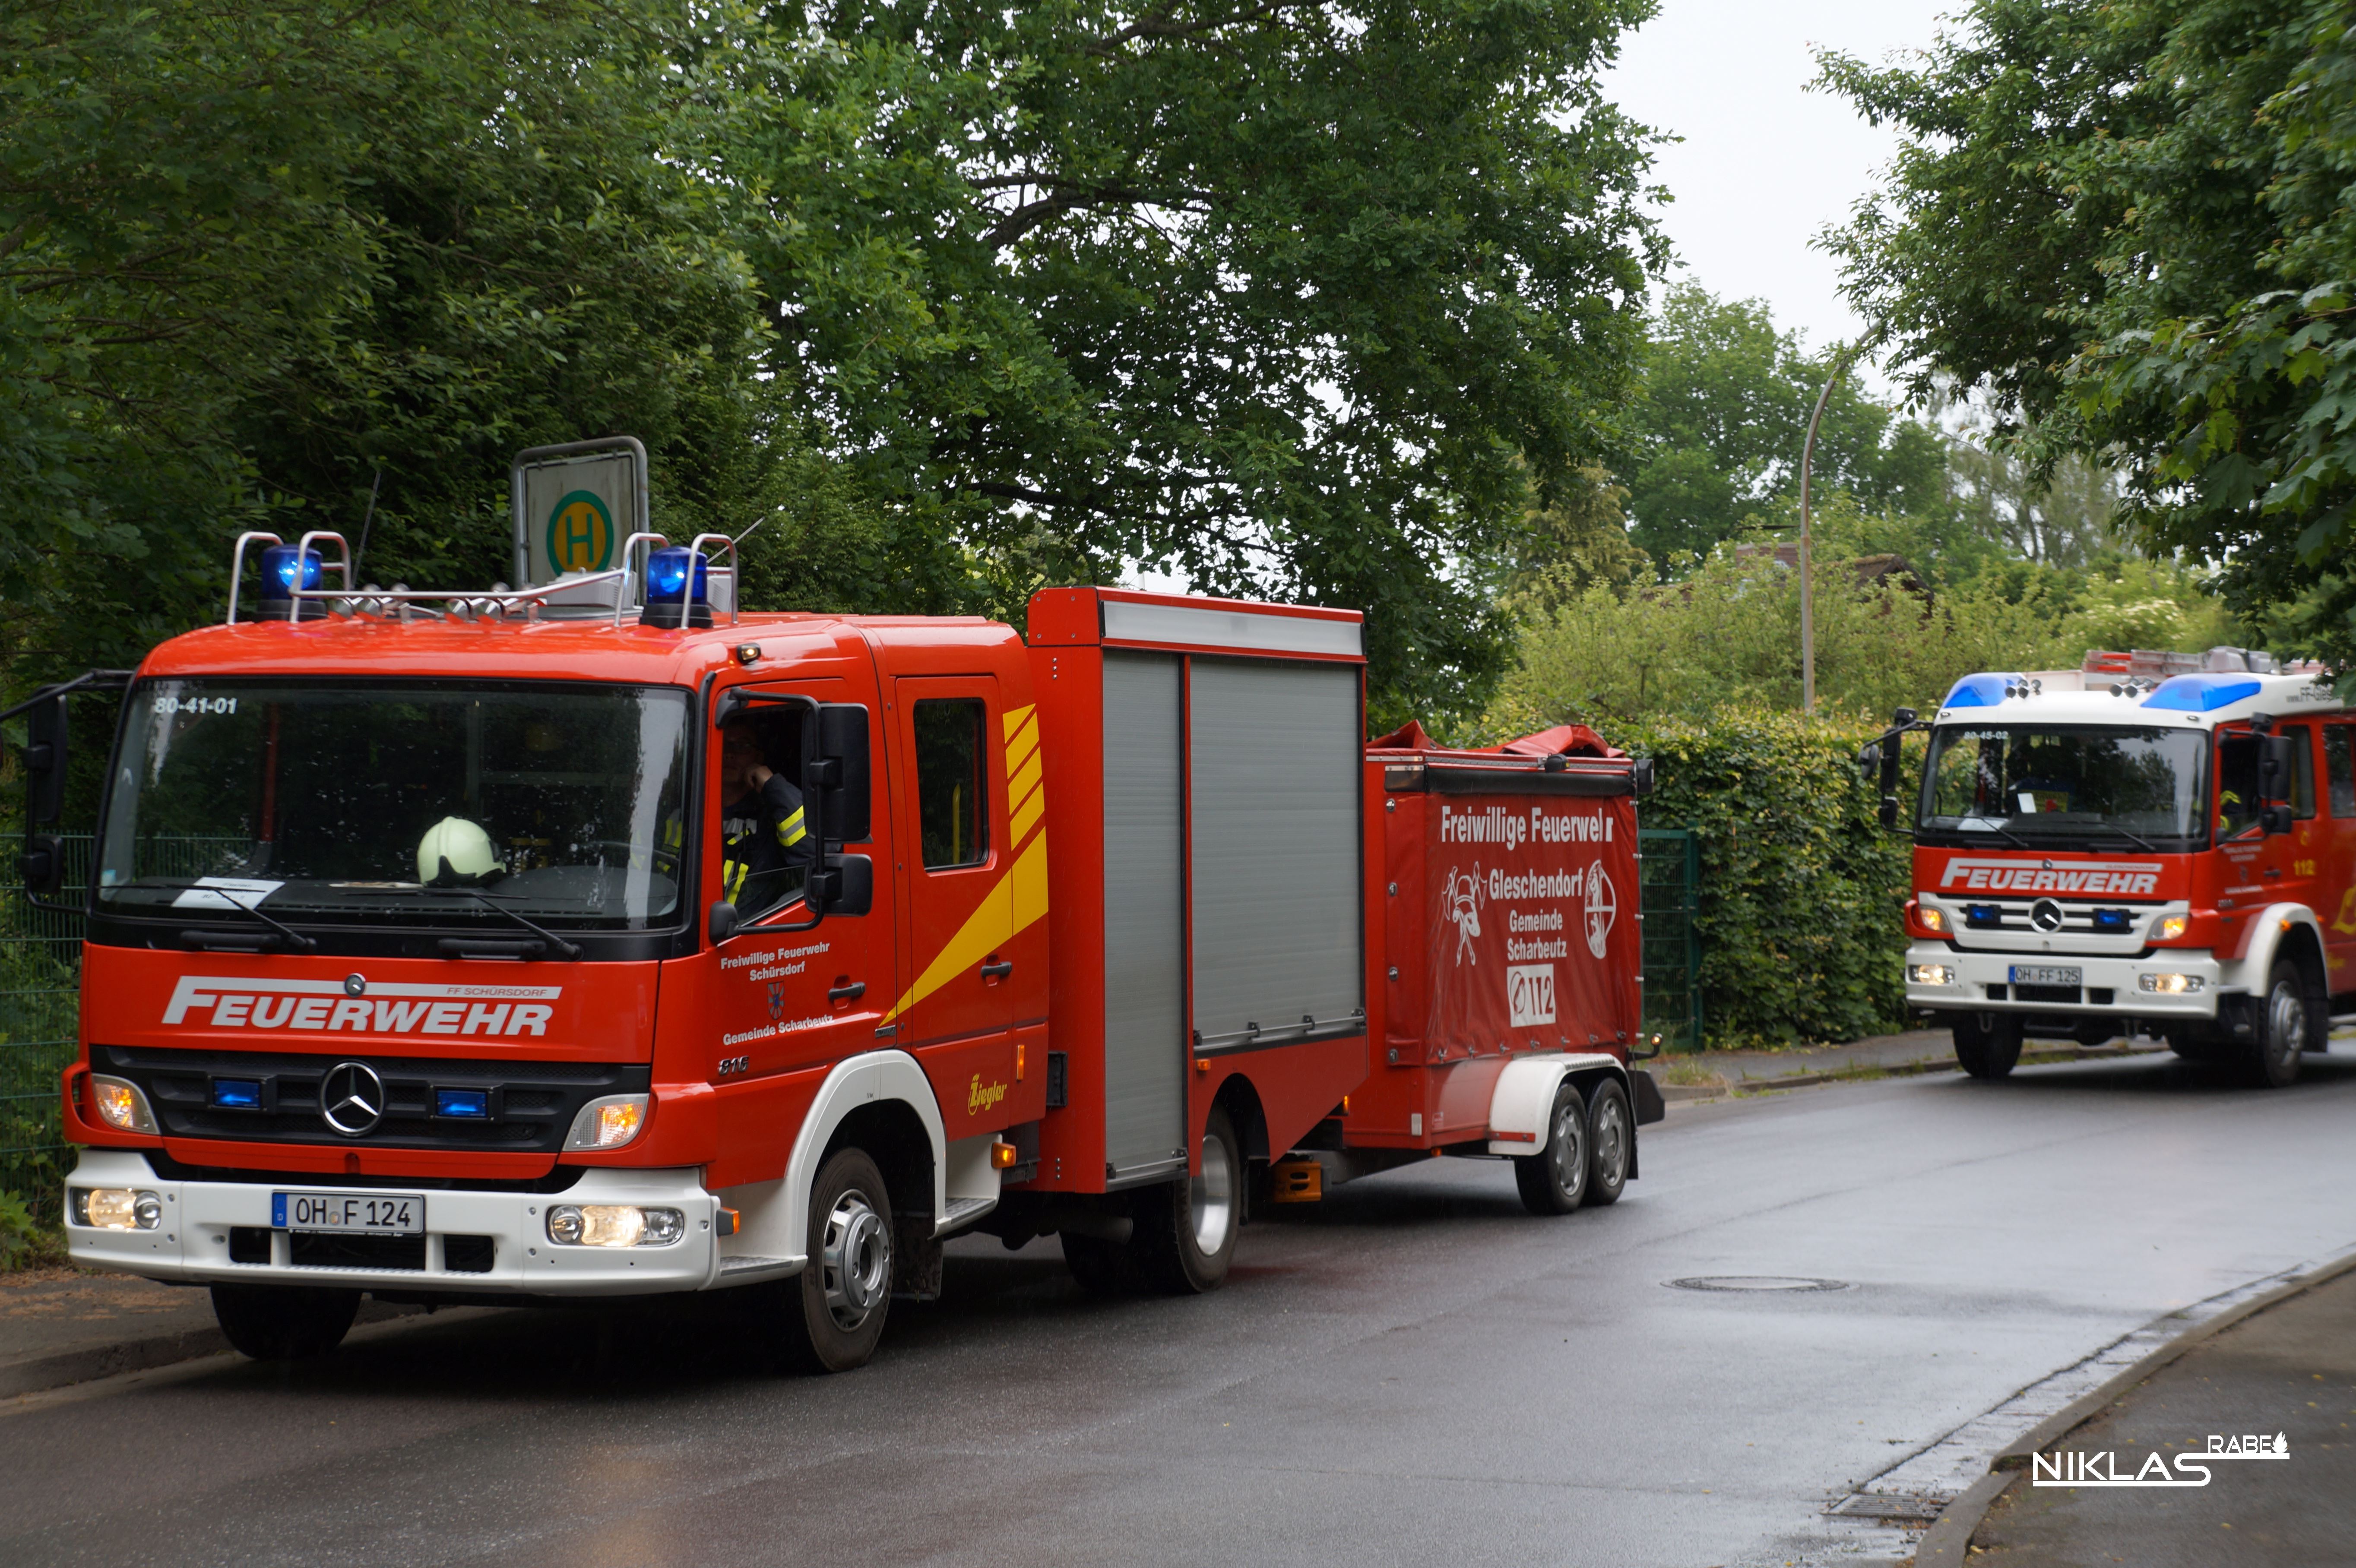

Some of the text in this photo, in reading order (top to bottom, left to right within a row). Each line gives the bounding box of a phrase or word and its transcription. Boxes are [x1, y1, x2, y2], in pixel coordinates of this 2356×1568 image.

[566, 513, 594, 565] H
[154, 697, 237, 714] 80-41-01
[1963, 731, 2009, 740] 80-45-02
[1441, 806, 1526, 850] Freiwillige
[1940, 857, 2158, 894] FEUERWEHR
[2293, 860, 2315, 876] 112
[1489, 867, 1583, 900] Gleschendorf
[1509, 908, 1563, 933] Gemeinde
[721, 942, 830, 970] Freiwillige Feuerwehr
[1507, 937, 1567, 961] Scharbeutz
[750, 961, 805, 981] Schürsdorf
[2016, 967, 2078, 982] OH FF 125
[162, 975, 554, 1036] FEUERWEHR
[464, 987, 548, 996] SCHÜRSDORF
[1529, 975, 1553, 1016] 112
[723, 1015, 835, 1046] Gemeinde Scharbeutz
[718, 1056, 749, 1075] 816
[969, 1075, 1007, 1114] Ziegler
[296, 1198, 326, 1224] OH
[345, 1200, 359, 1225] F
[366, 1201, 411, 1227] 124
